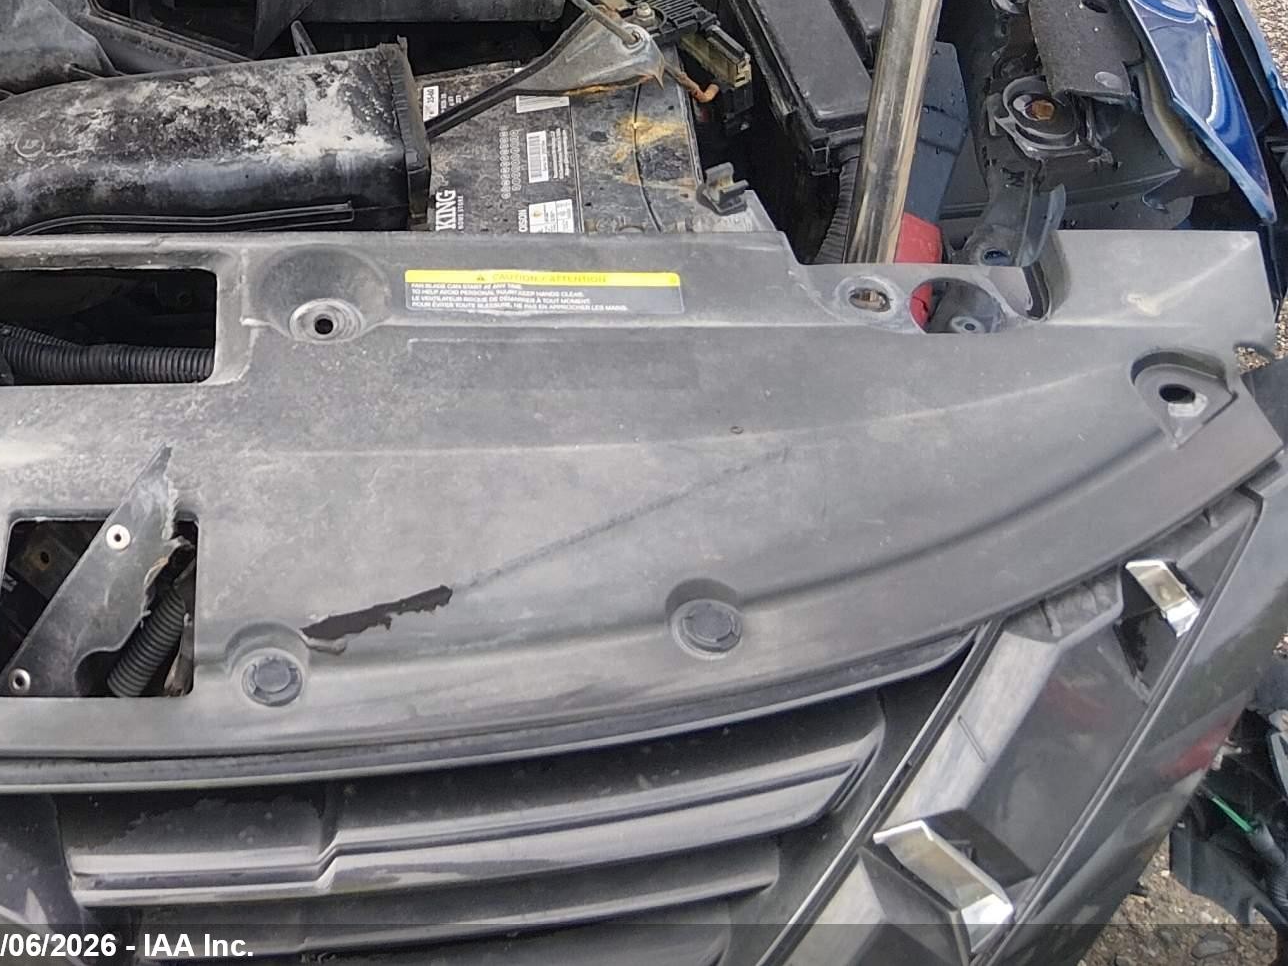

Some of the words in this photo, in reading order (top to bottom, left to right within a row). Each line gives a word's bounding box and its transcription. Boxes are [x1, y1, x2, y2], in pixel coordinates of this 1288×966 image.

[435, 190, 456, 231] KING
[518, 209, 528, 232] OISON
[492, 274, 537, 282] CAUTION
[548, 274, 606, 283] ATTENTION
